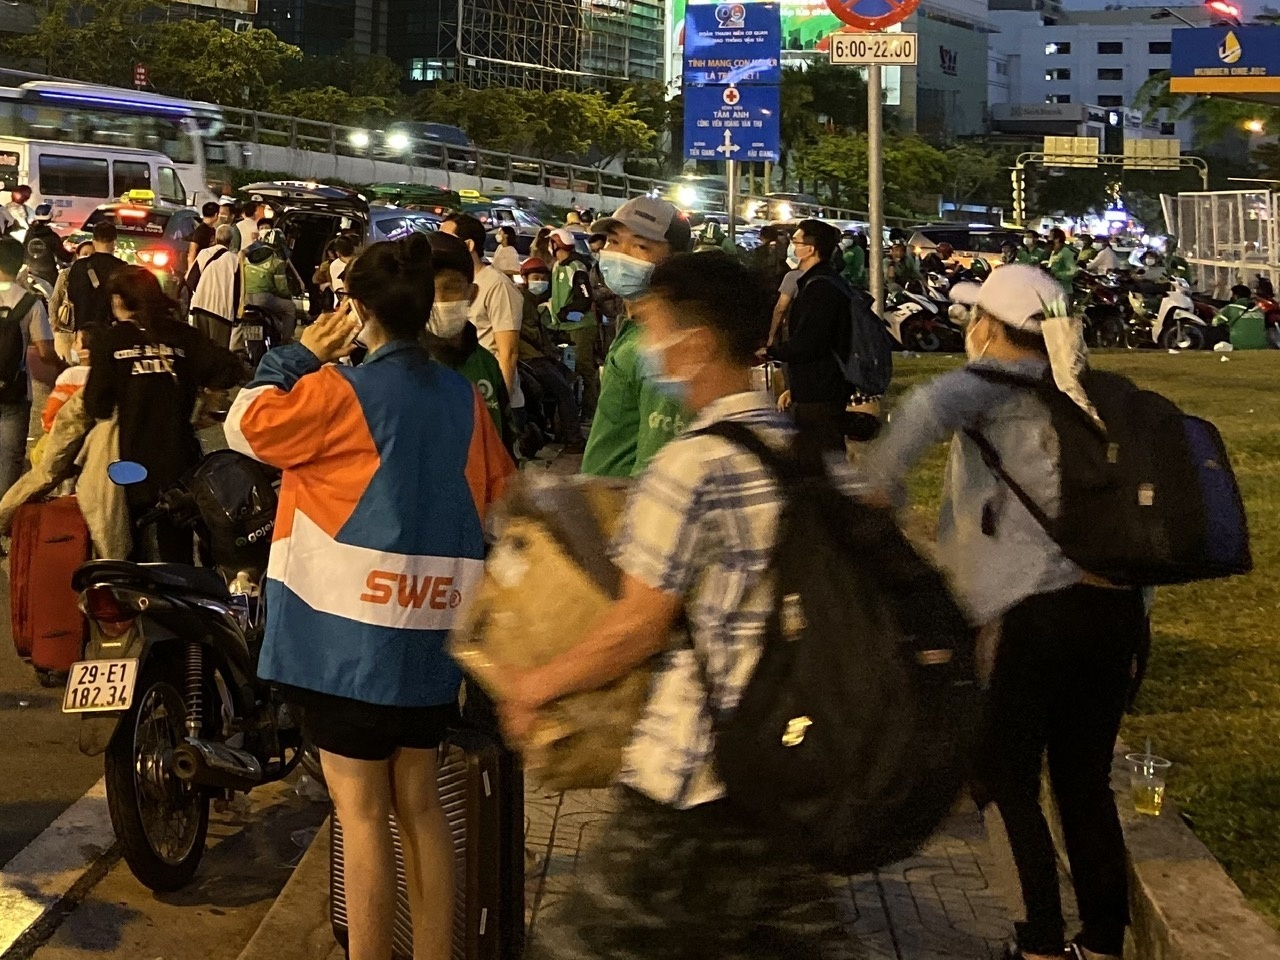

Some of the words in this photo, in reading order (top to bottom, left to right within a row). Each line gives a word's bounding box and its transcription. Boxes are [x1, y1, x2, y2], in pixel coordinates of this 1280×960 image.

[689, 58, 705, 67] TÍNH
[708, 59, 731, 68] MẠNG
[733, 59, 749, 67] CON
[713, 110, 729, 118] TÂM
[78, 663, 127, 685] 29-E1
[71, 685, 127, 708] 182.34
